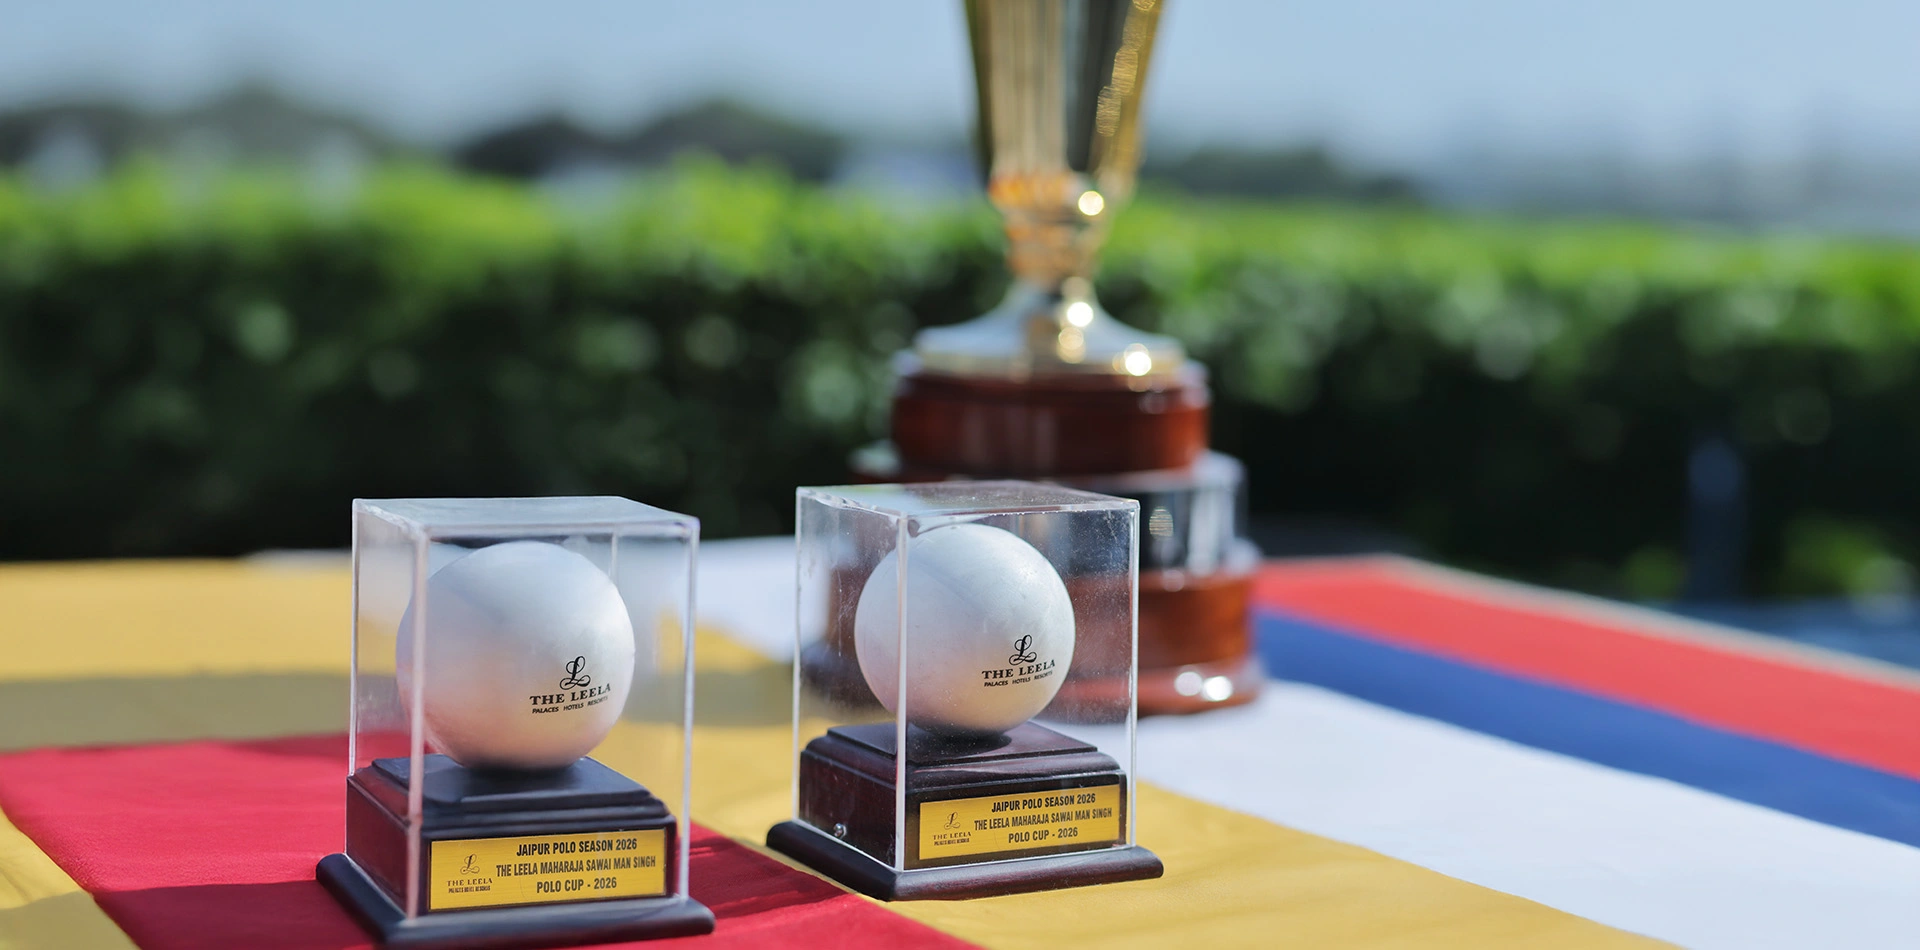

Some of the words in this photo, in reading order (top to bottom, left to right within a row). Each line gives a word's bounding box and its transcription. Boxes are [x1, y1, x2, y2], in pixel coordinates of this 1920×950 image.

[981, 668, 1014, 680] THE
[1019, 659, 1055, 676] LEELA
[1012, 677, 1031, 685] HOTELS
[529, 693, 565, 706] THE
[570, 683, 611, 702] LEELA
[531, 706, 559, 714] PALACES
[563, 702, 584, 711] HOTELS
[991, 800, 1020, 813] JAIPUR
[1022, 797, 1042, 809] POLO
[1044, 795, 1075, 808] SEASON
[1077, 793, 1096, 804] 2026
[974, 819, 987, 831] THE
[989, 817, 1010, 830] LEELA
[1011, 813, 1050, 827] MAHARAJA
[1051, 811, 1073, 823] SAWAI
[1074, 809, 1091, 820] MAN
[1092, 807, 1112, 819] SINGH
[950, 831, 972, 839] LEELA
[1008, 831, 1030, 843] POLO
[1032, 829, 1050, 841] CUP
[1057, 827, 1078, 838] 2026
[516, 843, 551, 857] JAIPUR
[552, 841, 576, 854] POLO
[578, 839, 613, 853] SEASON
[615, 838, 638, 850] 2026
[496, 864, 512, 877] THE
[513, 862, 538, 876] LEELA
[540, 860, 584, 875] MAHARAJA
[586, 858, 611, 871] SAWAI
[613, 857, 631, 869] MAN
[633, 855, 656, 868] SINGH
[447, 879, 464, 887] THE
[467, 877, 493, 885] LEELA
[536, 880, 561, 893] POLO
[564, 879, 584, 892] CUP
[593, 877, 617, 890] 2026
